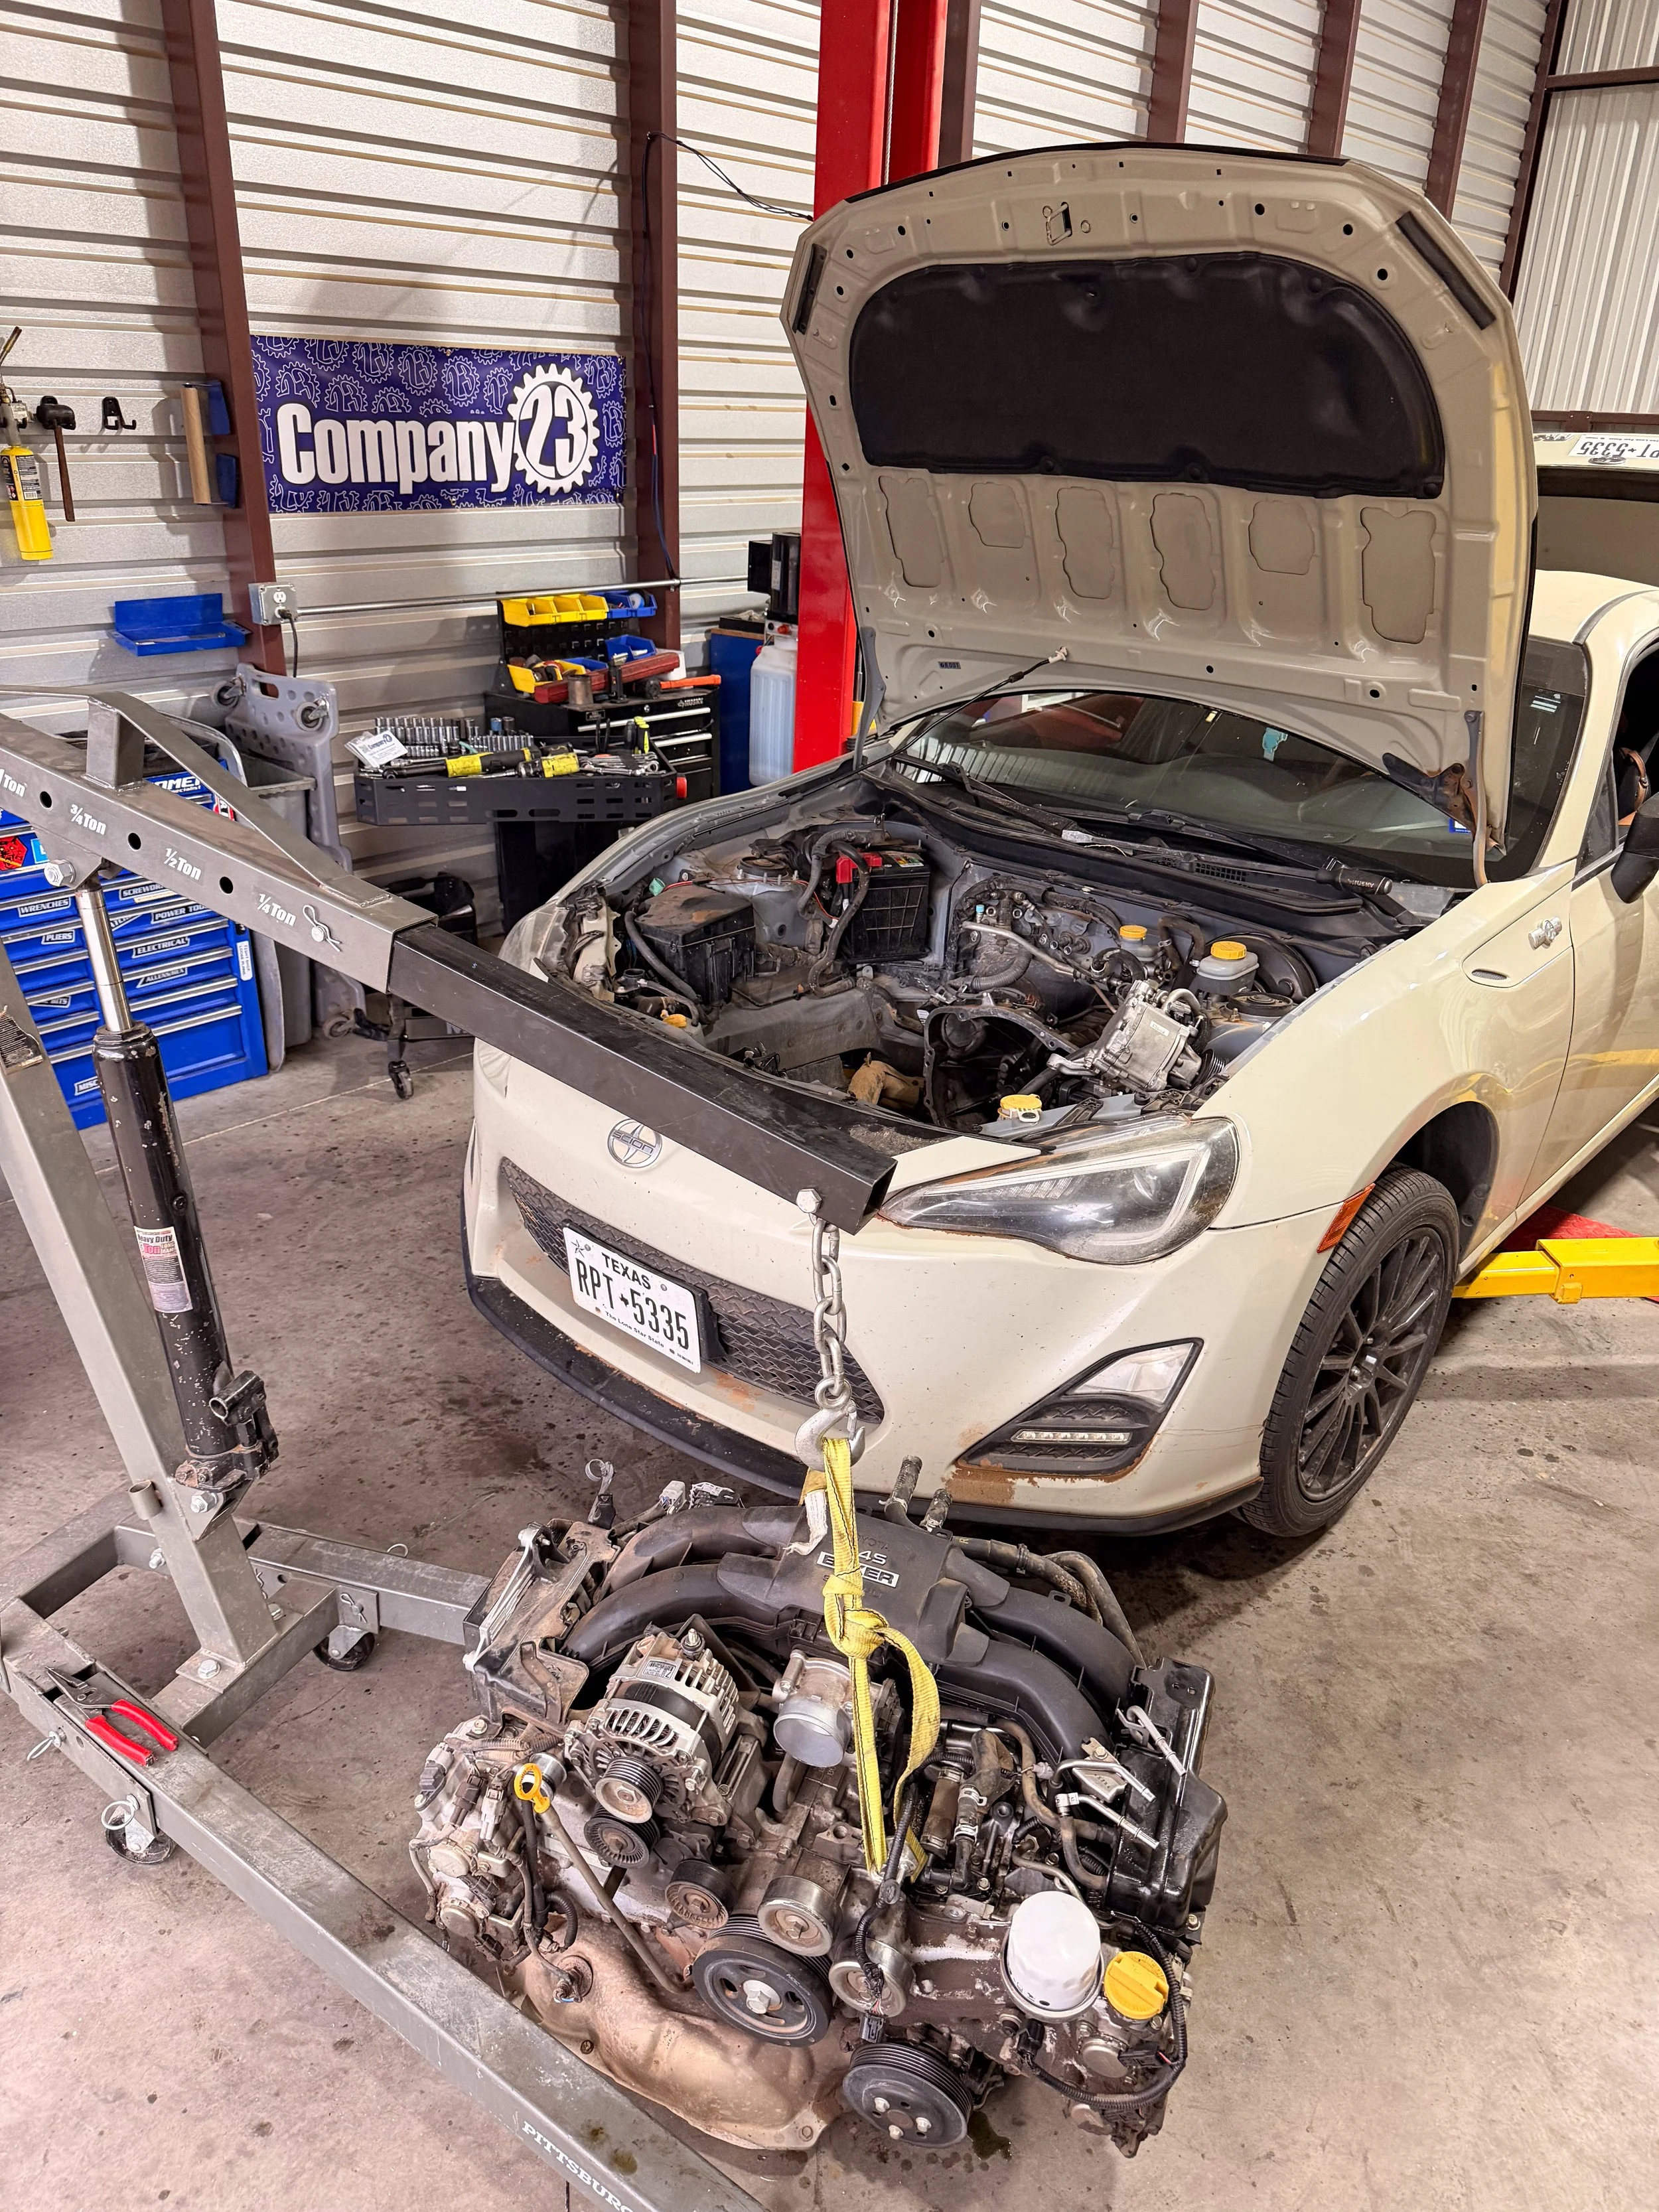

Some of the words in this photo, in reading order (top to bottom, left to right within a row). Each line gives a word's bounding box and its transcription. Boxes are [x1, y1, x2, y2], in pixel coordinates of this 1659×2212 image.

[277, 403, 515, 494] Company
[1577, 441, 1629, 457] 5335
[20, 898, 69, 915] WRENCHES
[155, 908, 186, 921] POWER
[46, 932, 74, 942] PLIERS
[137, 938, 186, 954] ELECTRICAL
[143, 1243, 161, 1254] Ton
[601, 1252, 651, 1290] TEXAS
[575, 1258, 614, 1309] RPT
[630, 1288, 689, 1350] 5335
[605, 1310, 616, 1321] The
[634, 1327, 646, 1338] Star
[648, 1335, 664, 1347] State
